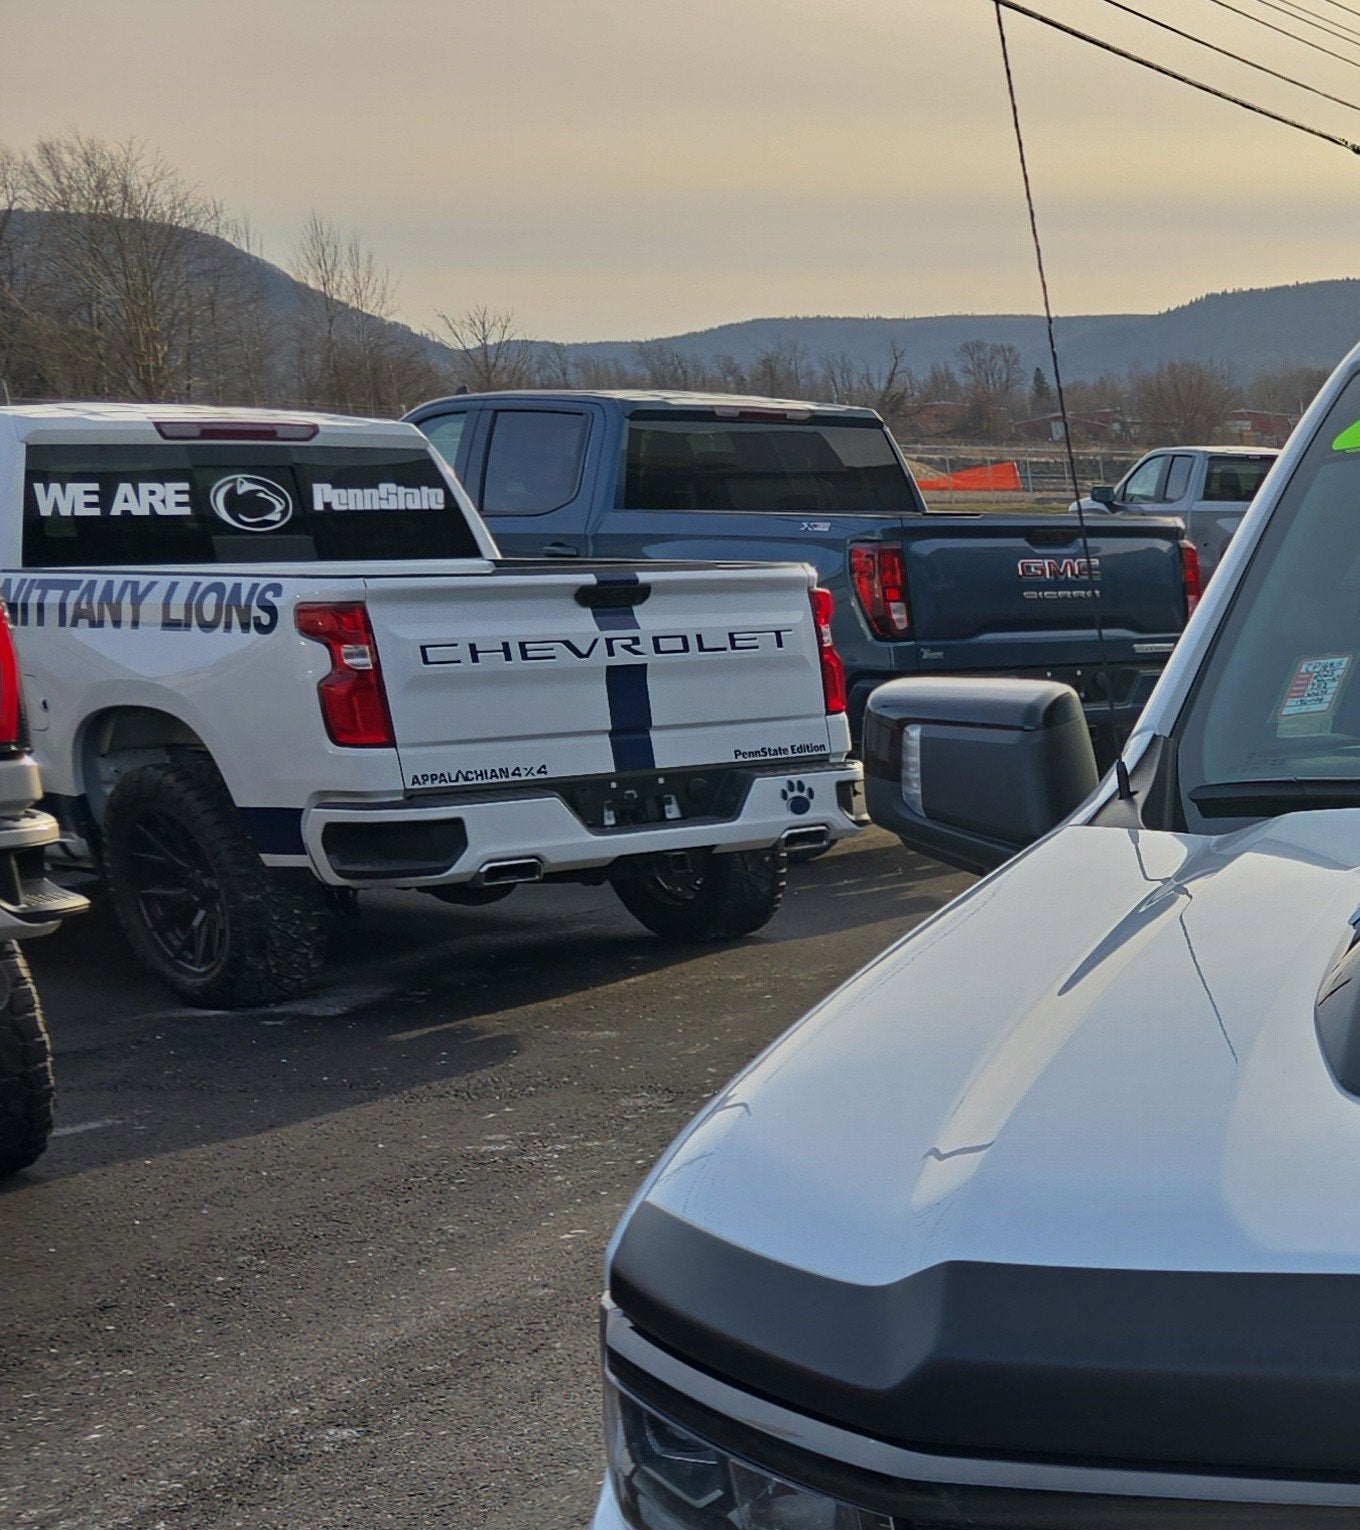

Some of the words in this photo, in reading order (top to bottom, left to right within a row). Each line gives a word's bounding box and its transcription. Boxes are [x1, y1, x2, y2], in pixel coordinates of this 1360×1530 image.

[33, 483, 100, 517] WE
[110, 483, 191, 516] ARE
[1018, 558, 1101, 580] GMC
[160, 580, 284, 635] LIONS
[418, 629, 793, 666] CHEVROLET
[789, 742, 826, 755] Edition
